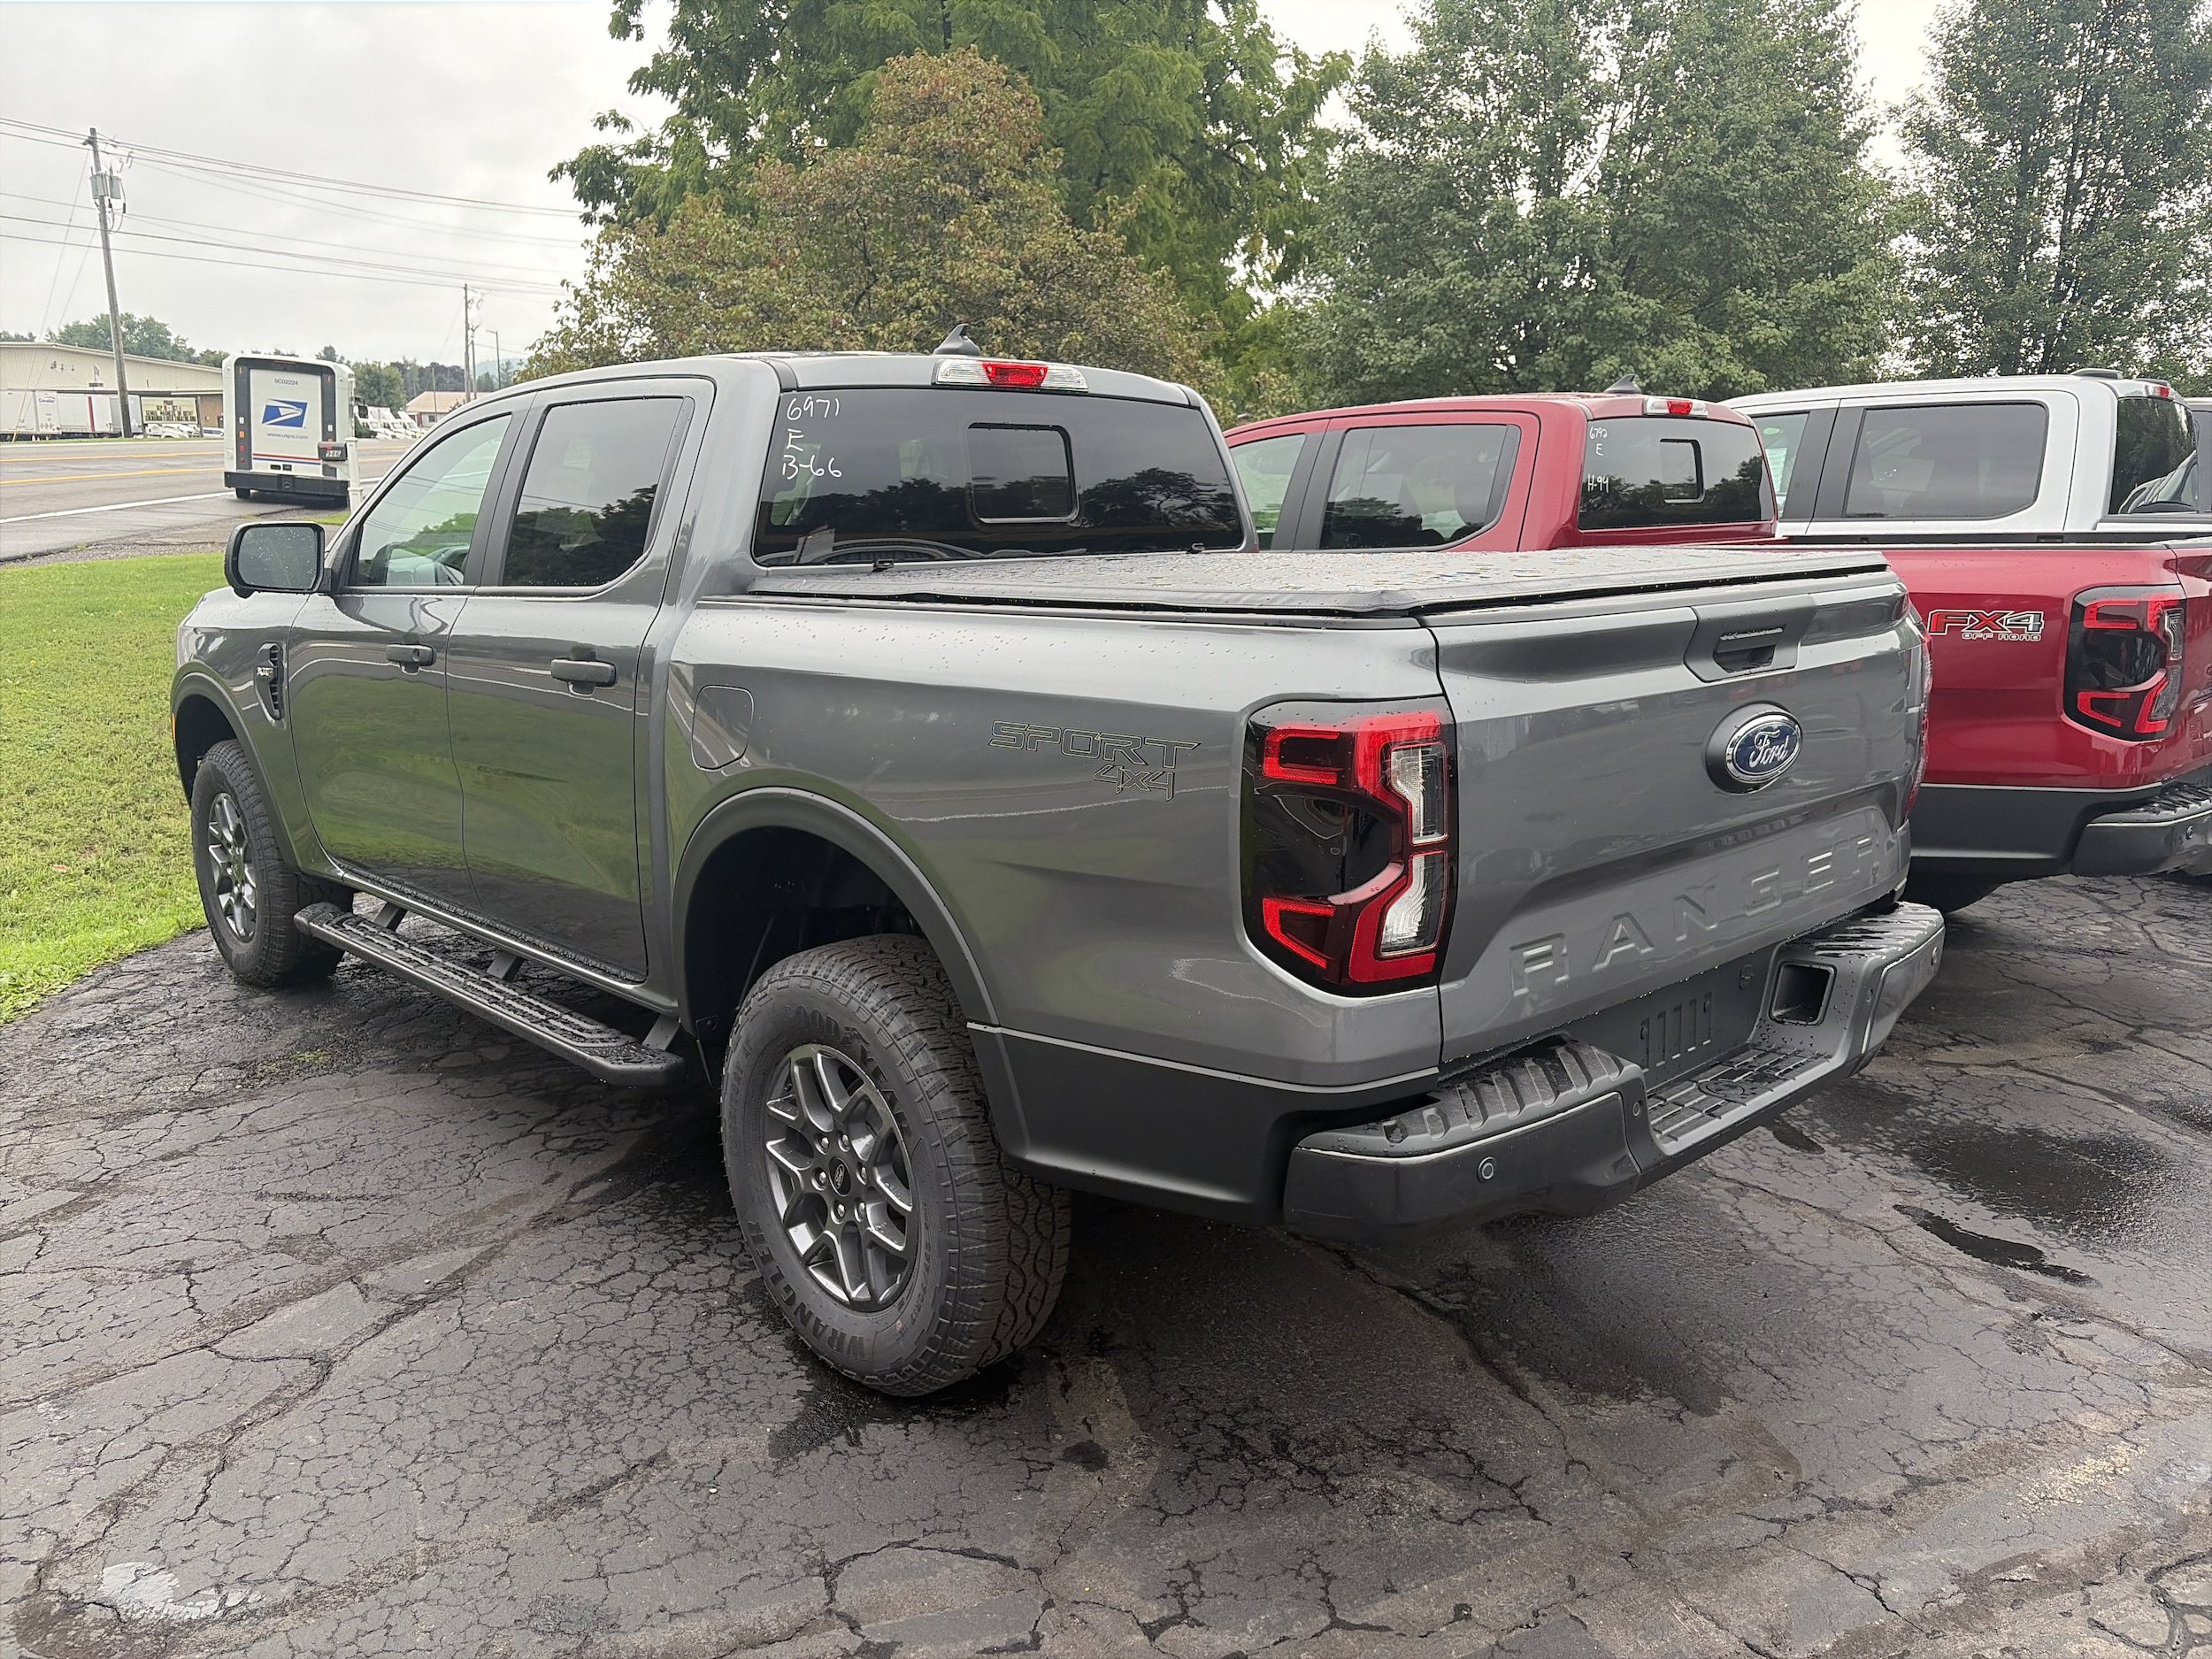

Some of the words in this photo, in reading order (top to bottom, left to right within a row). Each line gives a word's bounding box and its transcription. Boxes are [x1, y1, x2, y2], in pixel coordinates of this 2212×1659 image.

[787, 396, 840, 420] 6971
[787, 428, 804, 452] E
[1595, 442, 1604, 457] E
[1587, 473, 1609, 494] H-94
[1927, 609, 2045, 635] FX4
[1962, 632, 1994, 641] OFF
[1998, 633, 2042, 642] ROAD
[987, 719, 1202, 769] SPORT
[1748, 729, 1789, 768] Ford
[1508, 830, 1879, 997] RANGER
[747, 1219, 867, 1361] WRANGLER
